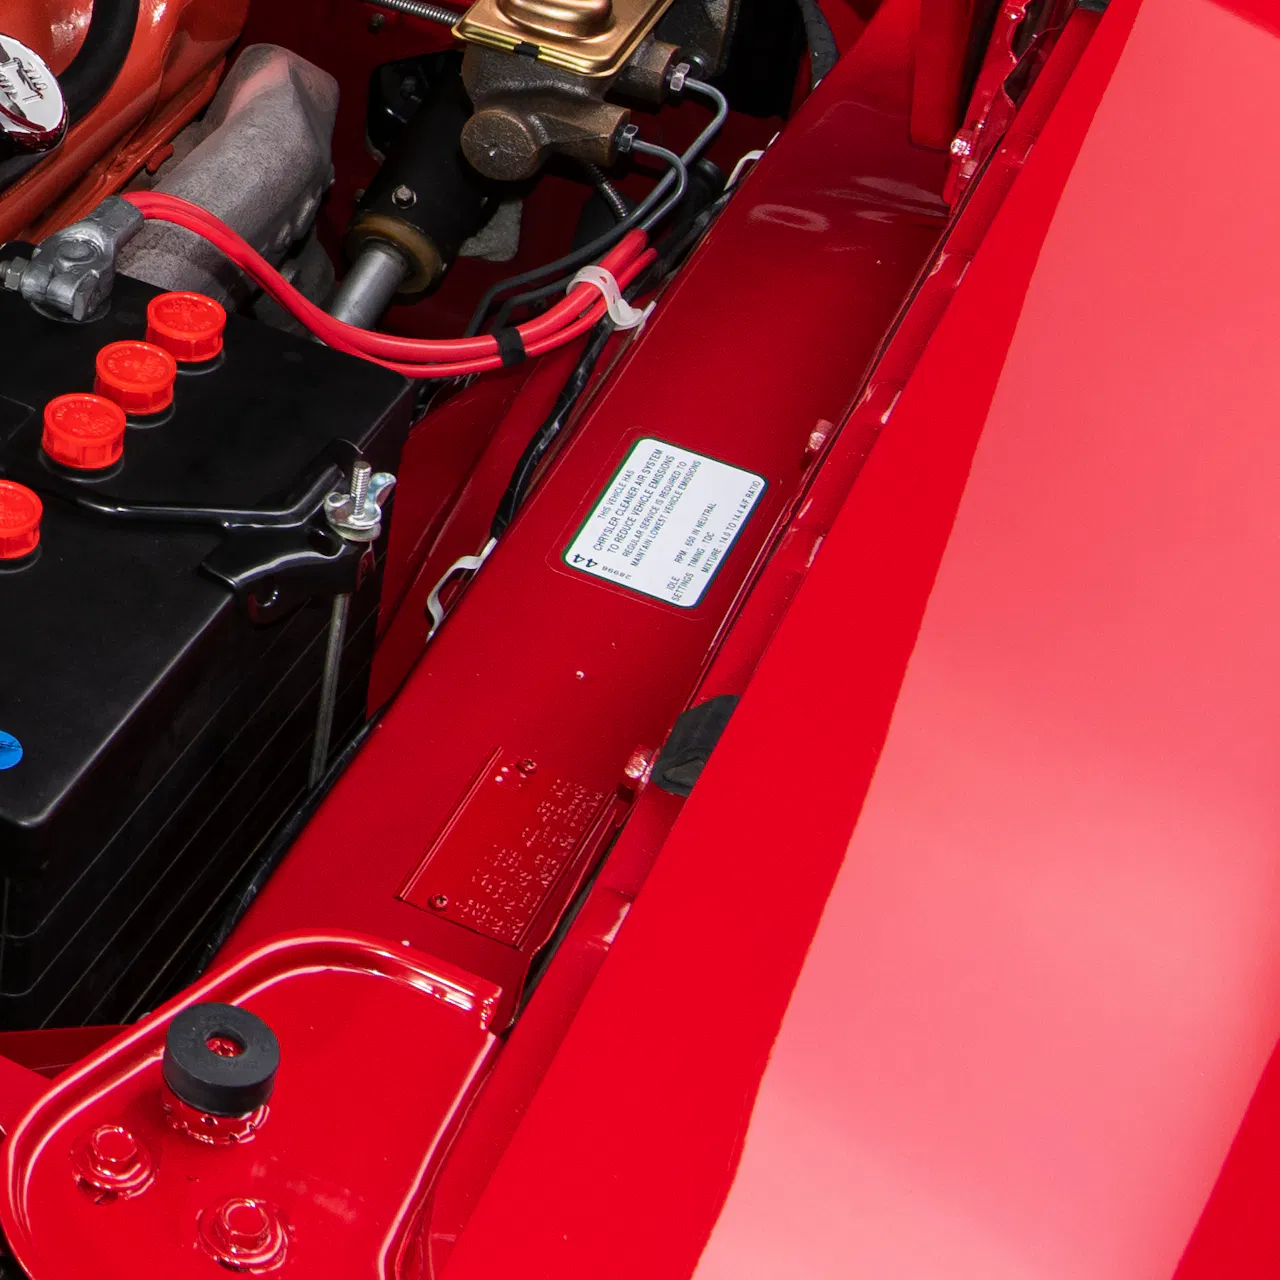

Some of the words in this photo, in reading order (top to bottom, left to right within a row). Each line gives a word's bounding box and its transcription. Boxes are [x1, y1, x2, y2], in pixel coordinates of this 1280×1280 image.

[592, 516, 620, 551] CHRYSLER
[614, 486, 639, 516] CLEANER
[634, 474, 646, 486] AIR
[641, 449, 663, 474] SYSTEM
[598, 506, 611, 519] THIS
[606, 482, 626, 505] VEHICLE
[621, 469, 634, 482] HAS
[607, 543, 619, 553] TO
[614, 516, 636, 543] REDUCE
[631, 489, 653, 516] VEHICLE
[648, 455, 675, 488] EMISSIONS
[622, 529, 644, 557] REGULAR
[639, 505, 659, 529] SERVICE
[659, 470, 681, 498] REQUIRED
[677, 461, 687, 469] TO
[630, 539, 652, 566] MAINTAIN
[647, 514, 667, 538] LOWEST
[663, 490, 682, 513] VEHICLE
[677, 460, 701, 490] EMISSIONS
[674, 550, 687, 563] RPM
[695, 502, 715, 528] NEUTRAL
[687, 547, 704, 567] TIMING
[700, 547, 721, 573] MIXTURE
[726, 522, 736, 530] TO
[745, 480, 761, 498] RATIO
[571, 553, 598, 569] 44
[666, 576, 679, 590] IDLE
[671, 572, 693, 601] SETTINGS
